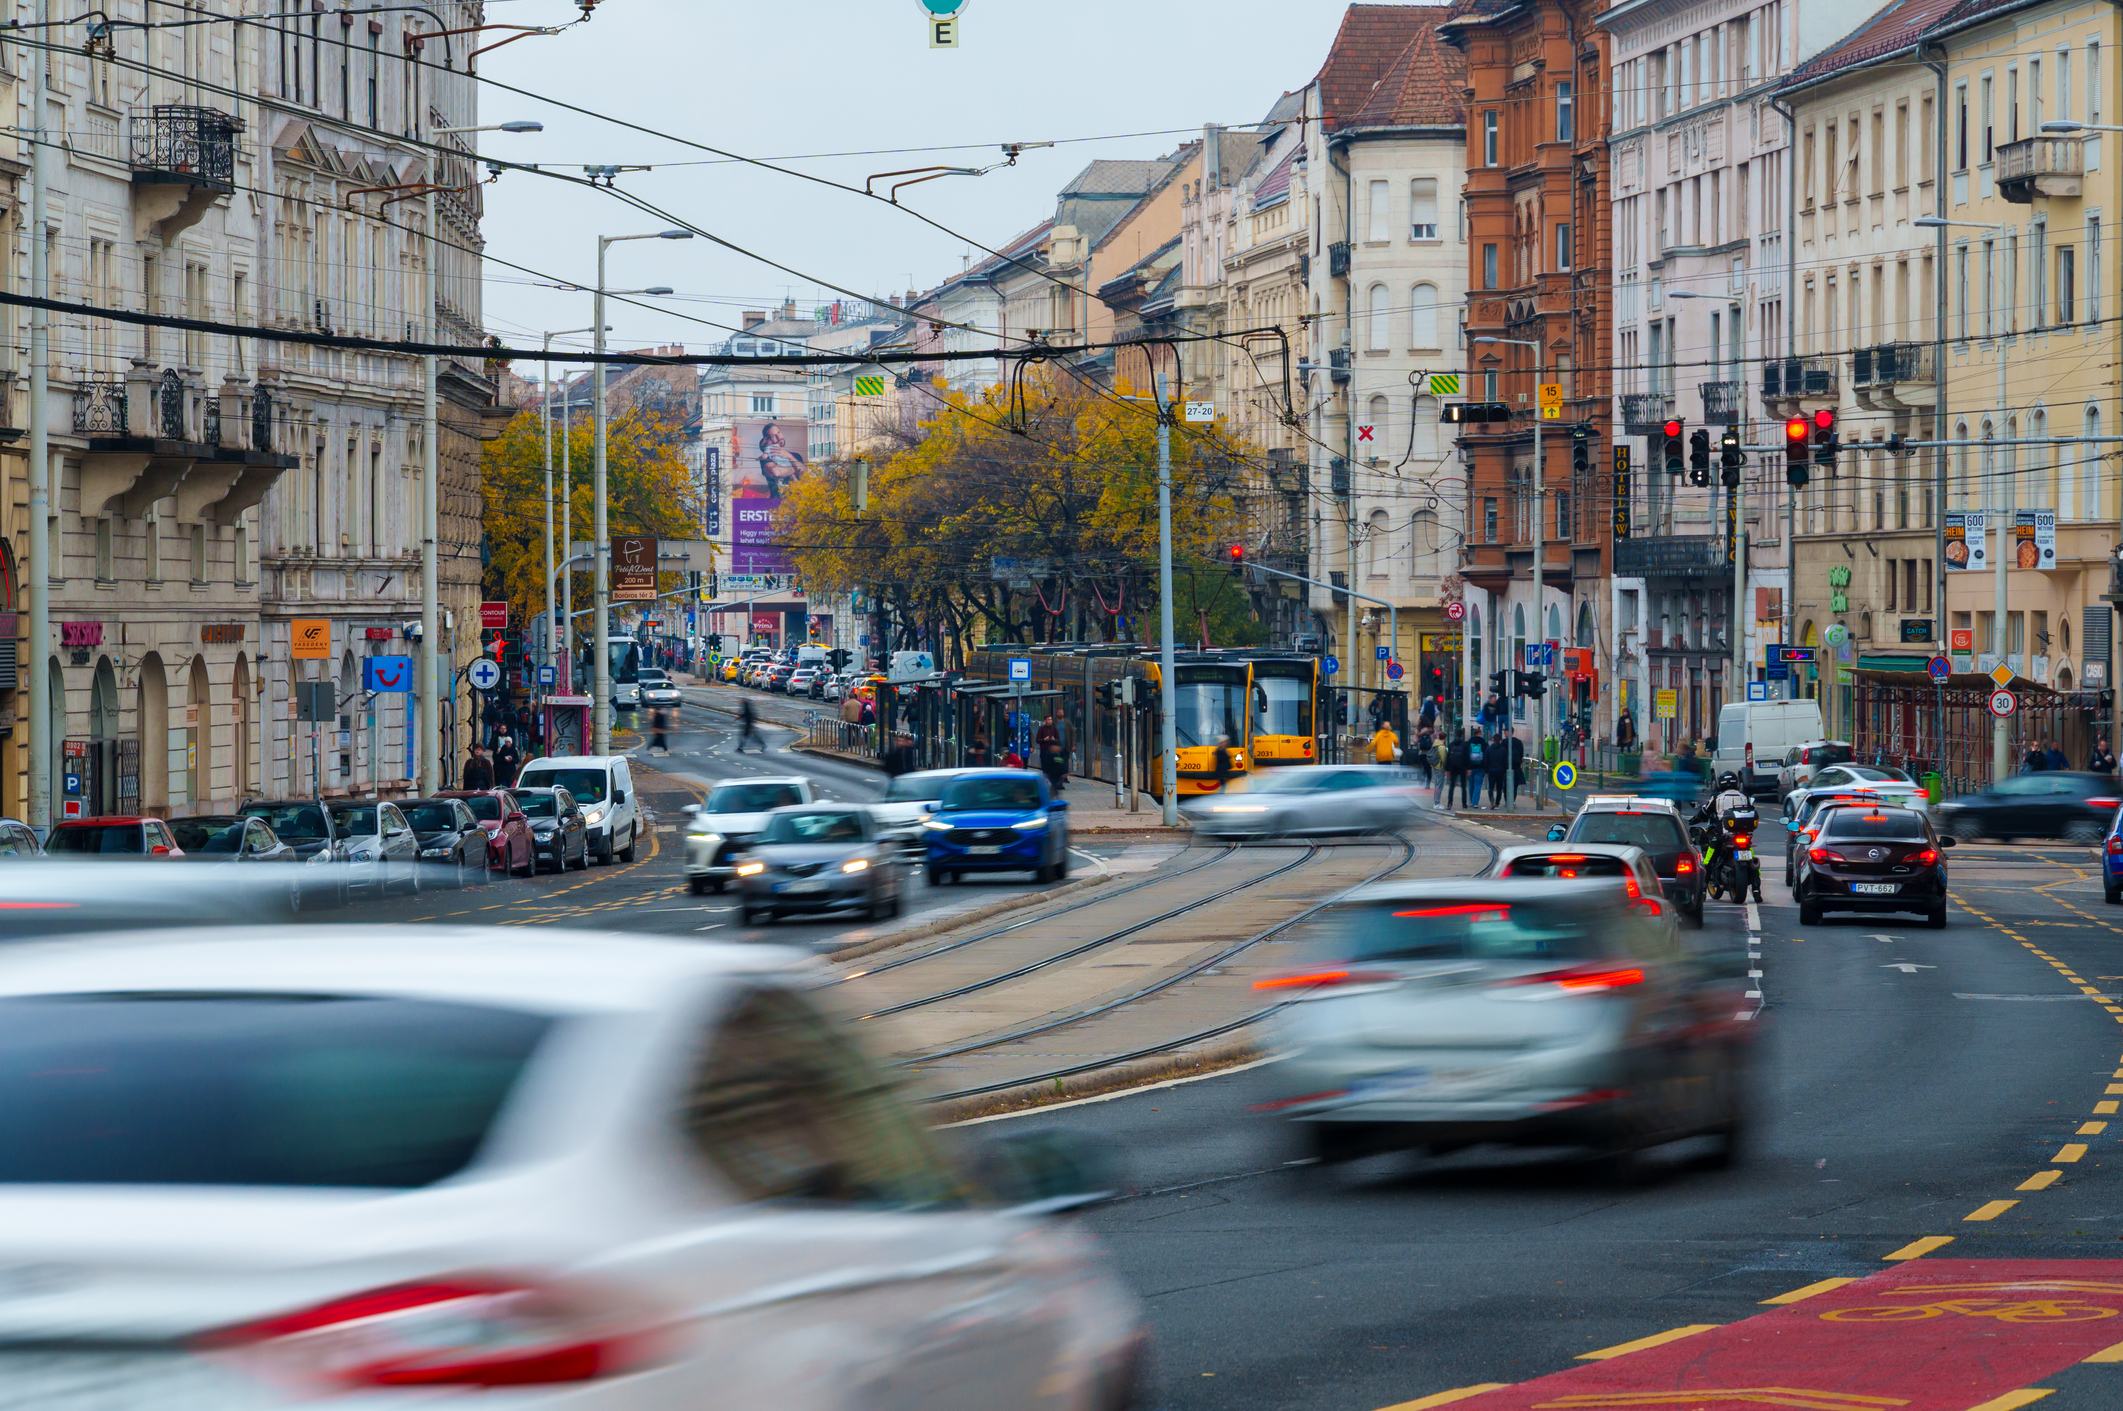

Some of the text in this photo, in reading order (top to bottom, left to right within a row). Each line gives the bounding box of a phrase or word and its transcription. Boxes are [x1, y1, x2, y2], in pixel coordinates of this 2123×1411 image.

[936, 22, 952, 44] E
[1545, 386, 1557, 397] 15
[1187, 407, 1213, 416] 27-20
[709, 452, 718, 475] plaza
[1616, 447, 1627, 508] HOTEL
[1967, 515, 1984, 527] 600
[2037, 514, 2054, 526] 600
[639, 591, 648, 599] tér
[2086, 664, 2103, 678] CASIO
[1996, 697, 2010, 709] 30
[1256, 750, 1273, 758] 2031
[67, 777, 79, 791] P
[1857, 884, 1893, 893] PVT-662
